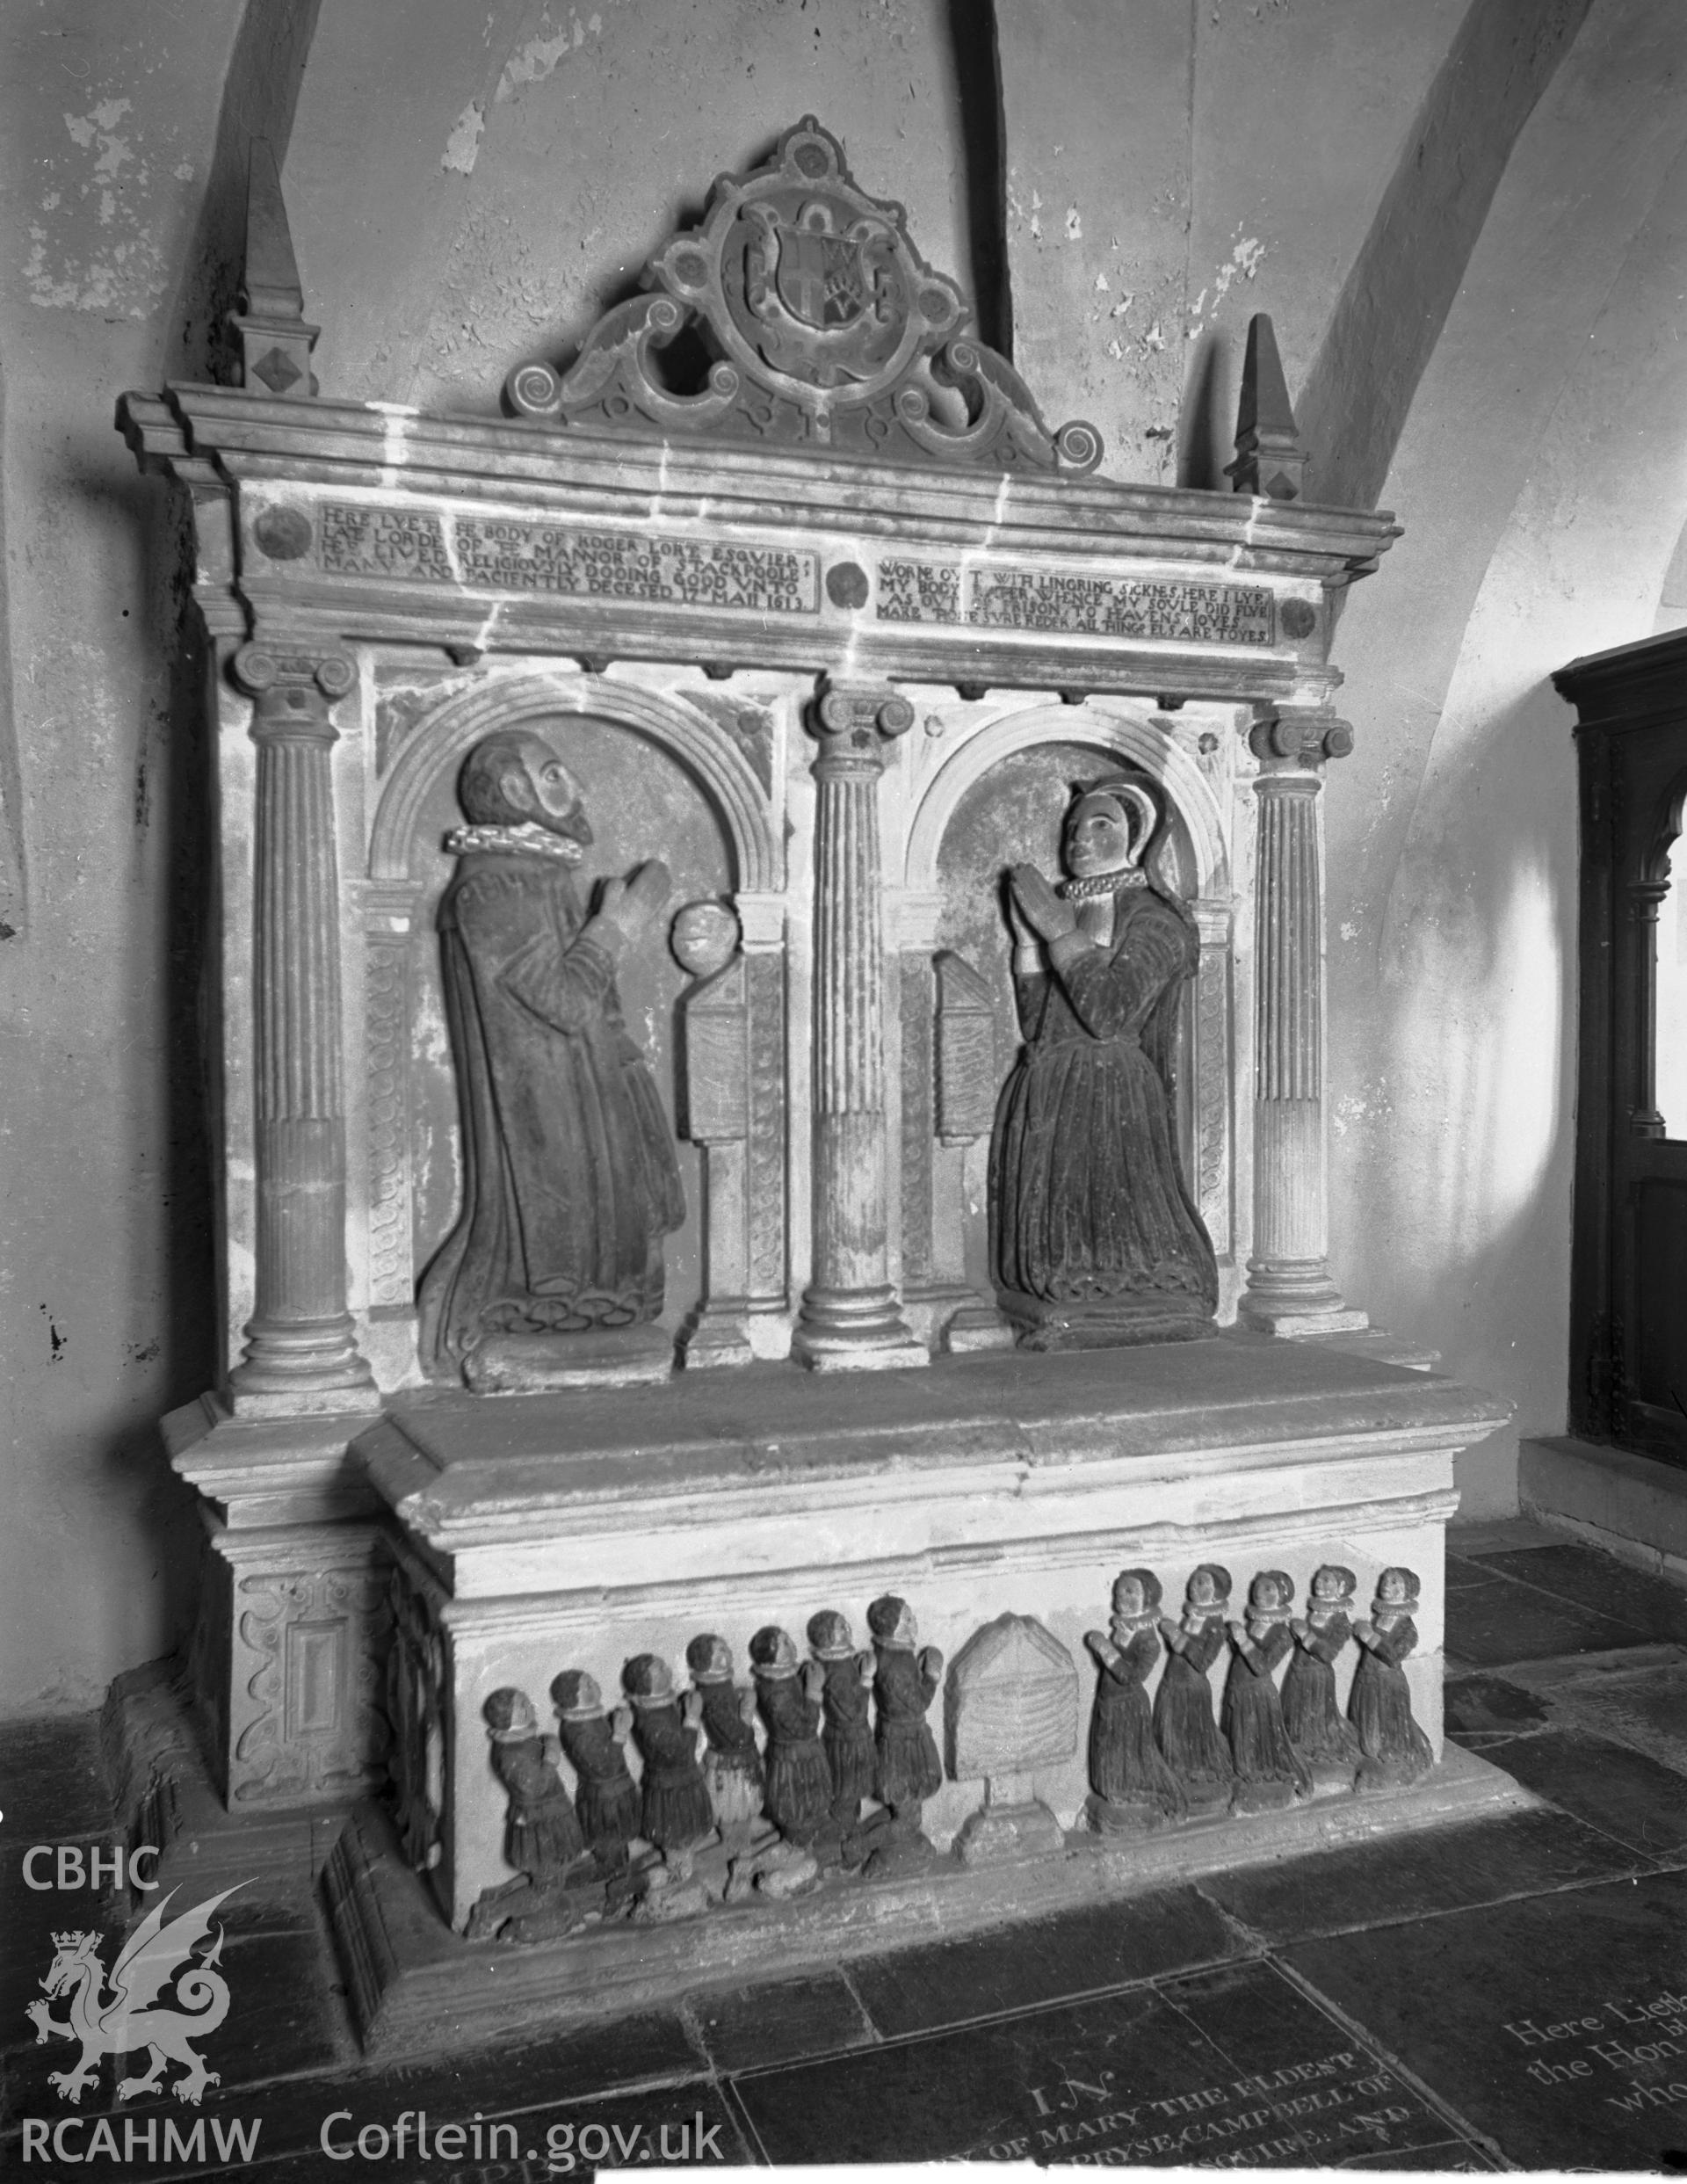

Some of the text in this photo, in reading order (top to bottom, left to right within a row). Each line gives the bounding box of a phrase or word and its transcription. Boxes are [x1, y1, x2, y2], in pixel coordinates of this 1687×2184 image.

[323, 506, 370, 526] HERE
[484, 525, 532, 543] BODY
[542, 531, 564, 545] OF
[578, 534, 638, 552] ROGER
[323, 525, 365, 541] LATE
[374, 528, 443, 548] LORDE
[457, 538, 482, 553] OF
[638, 555, 662, 569] OF
[324, 555, 395, 573] MANY
[411, 564, 453, 579] AND
[466, 568, 580, 590] PACIENTLY
[589, 579, 672, 599] DECESED
[374, 543, 447, 564] LIVED
[459, 552, 577, 577] RELIGIOVSLY
[585, 563, 660, 584] DOOING
[732, 577, 798, 595] VNTO
[879, 561, 933, 580] WORNE
[1039, 576, 1112, 594] LINGRING
[1183, 587, 1218, 602] HERE
[1222, 591, 1229, 603] I
[880, 577, 909, 592] MY
[918, 580, 959, 595] BODY
[1112, 596, 1140, 608] MY
[1148, 598, 1198, 613] SOVLE
[1206, 602, 1230, 615] DID
[1236, 605, 1267, 618] FLYE
[888, 593, 913, 606] AS
[922, 594, 959, 611] OVT
[1071, 605, 1096, 619] TO
[1107, 607, 1181, 625] HEAVENS
[1151, 624, 1175, 635] ELS
[1179, 627, 1212, 639] ARE
[1502, 2018, 1605, 2047] Here
[1525, 2057, 1594, 2086] the
[1029, 2071, 1115, 2117] IN
[1182, 2088, 1354, 2144] CAMPBELL
[1351, 2074, 1395, 2097] OF
[1603, 2080, 1687, 2113] who
[988, 2137, 1031, 2160] OF
[1037, 2108, 1140, 2149] MARY
[1150, 2087, 1229, 2117] THE
